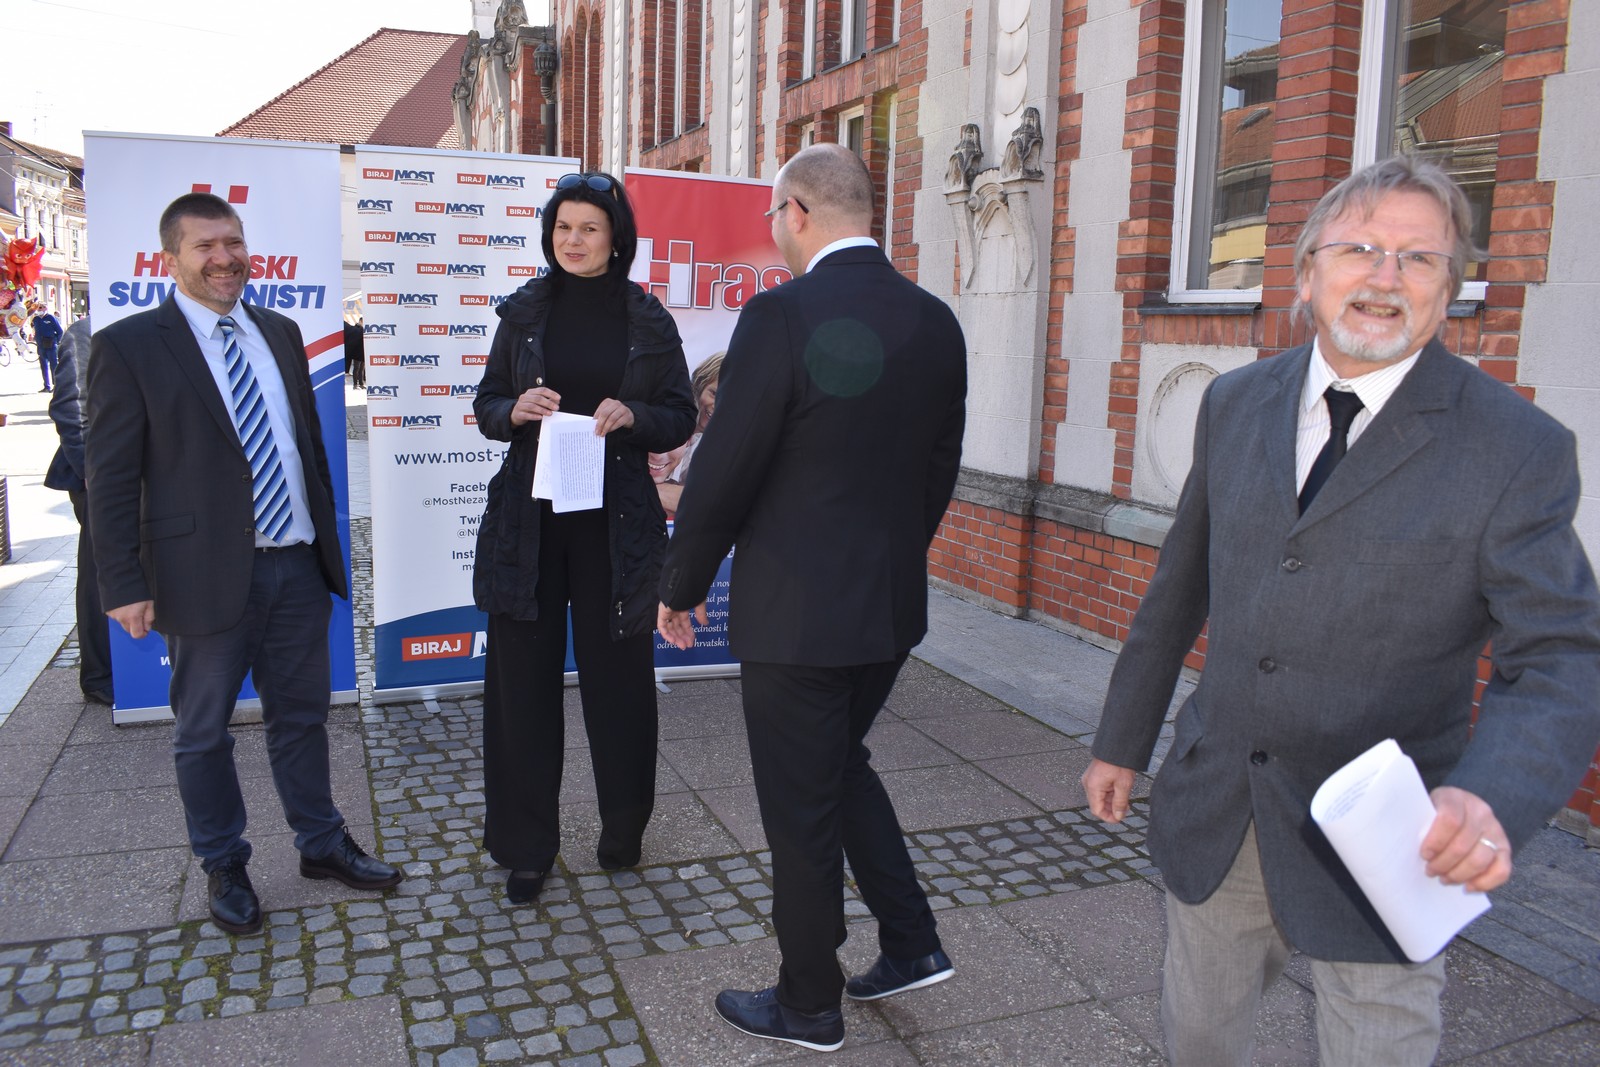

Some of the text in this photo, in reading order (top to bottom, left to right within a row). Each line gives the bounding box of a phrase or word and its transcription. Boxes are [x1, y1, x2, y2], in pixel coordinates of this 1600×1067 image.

[394, 170, 435, 183] MOST
[460, 175, 525, 188] BIRAJ MOST
[445, 203, 485, 216] MOST
[396, 231, 437, 245] MOST
[487, 235, 526, 248] MOST
[420, 264, 486, 277] BIRAJ MOST
[108, 281, 326, 309] SUVNISTI
[398, 293, 438, 306] MOST
[449, 324, 487, 336] MOST
[400, 355, 440, 367] MOST
[451, 384, 479, 396] MOS
[402, 415, 442, 428] MOST
[450, 482, 488, 493] Faceb
[460, 514, 482, 525] Twi
[452, 550, 475, 560] Inst
[411, 639, 462, 656] BIRAJ
